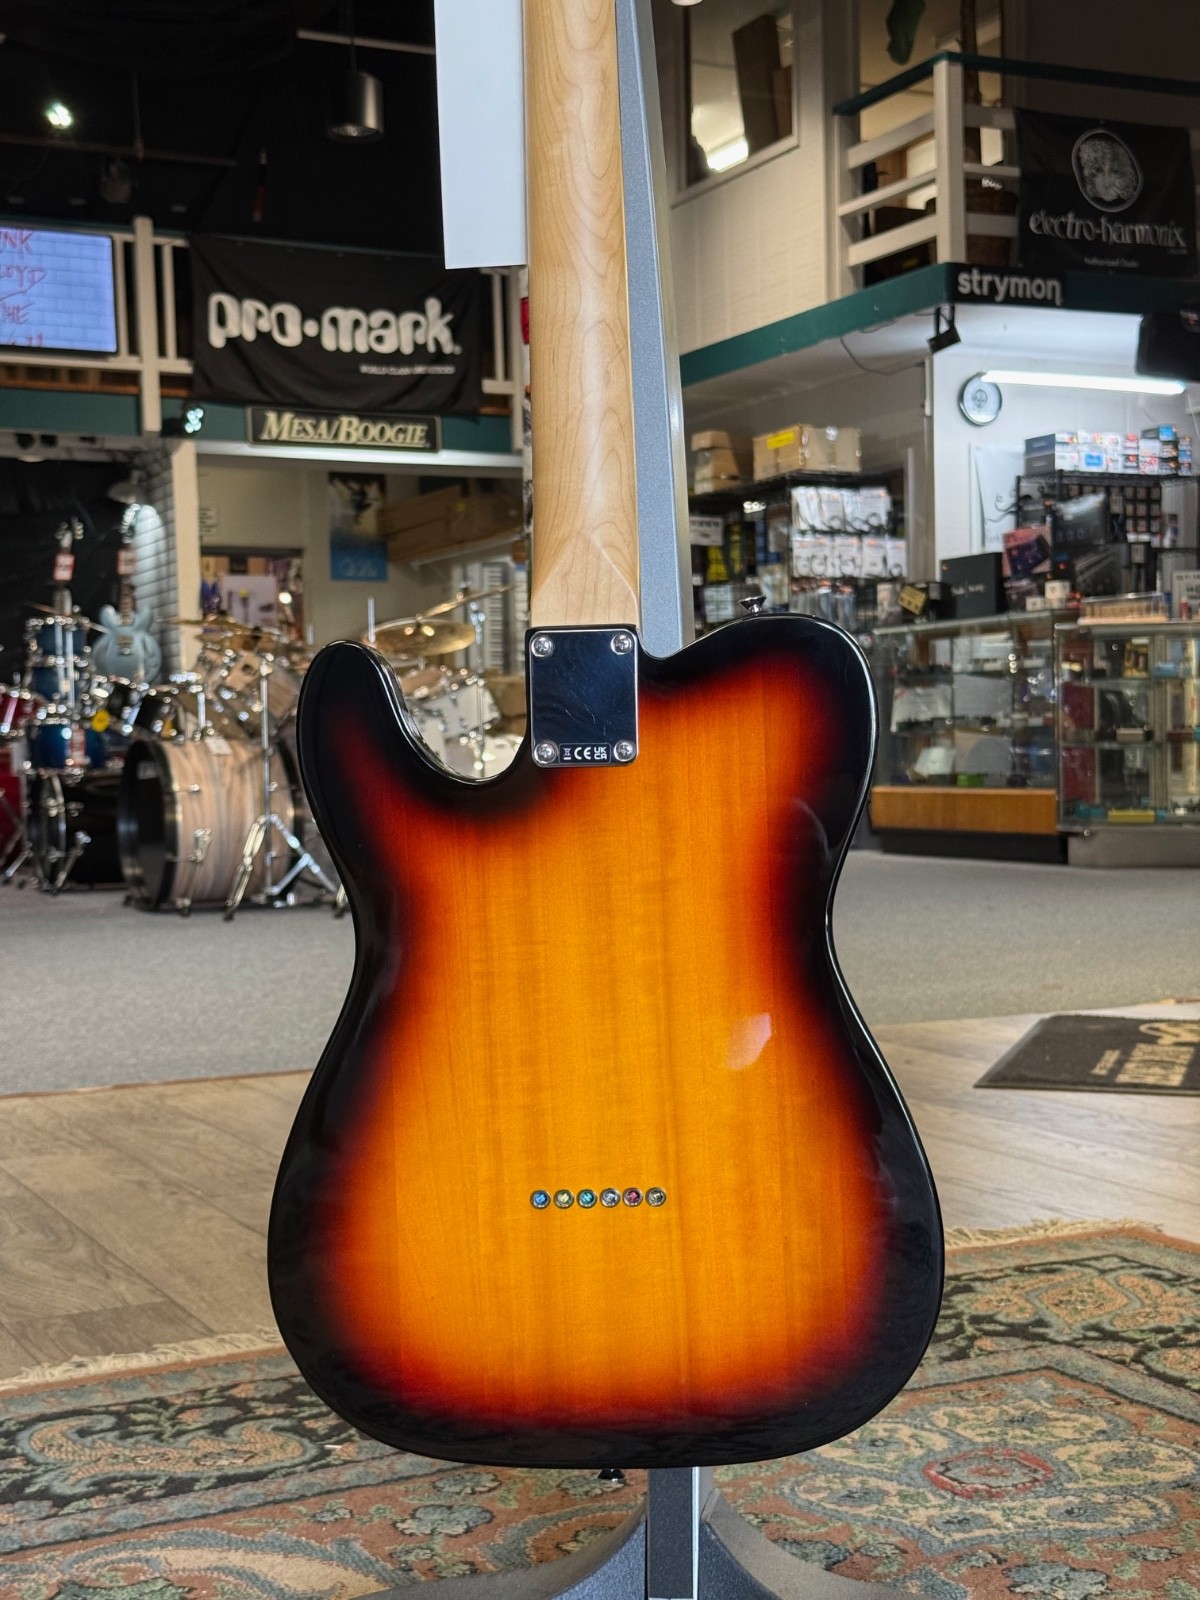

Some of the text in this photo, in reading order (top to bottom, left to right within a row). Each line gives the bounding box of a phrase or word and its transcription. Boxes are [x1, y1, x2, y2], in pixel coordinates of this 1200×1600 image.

[1029, 209, 1187, 248] electro-harmonix
[957, 267, 1062, 306] strymon
[260, 410, 429, 447] MESA/BOOGIE
